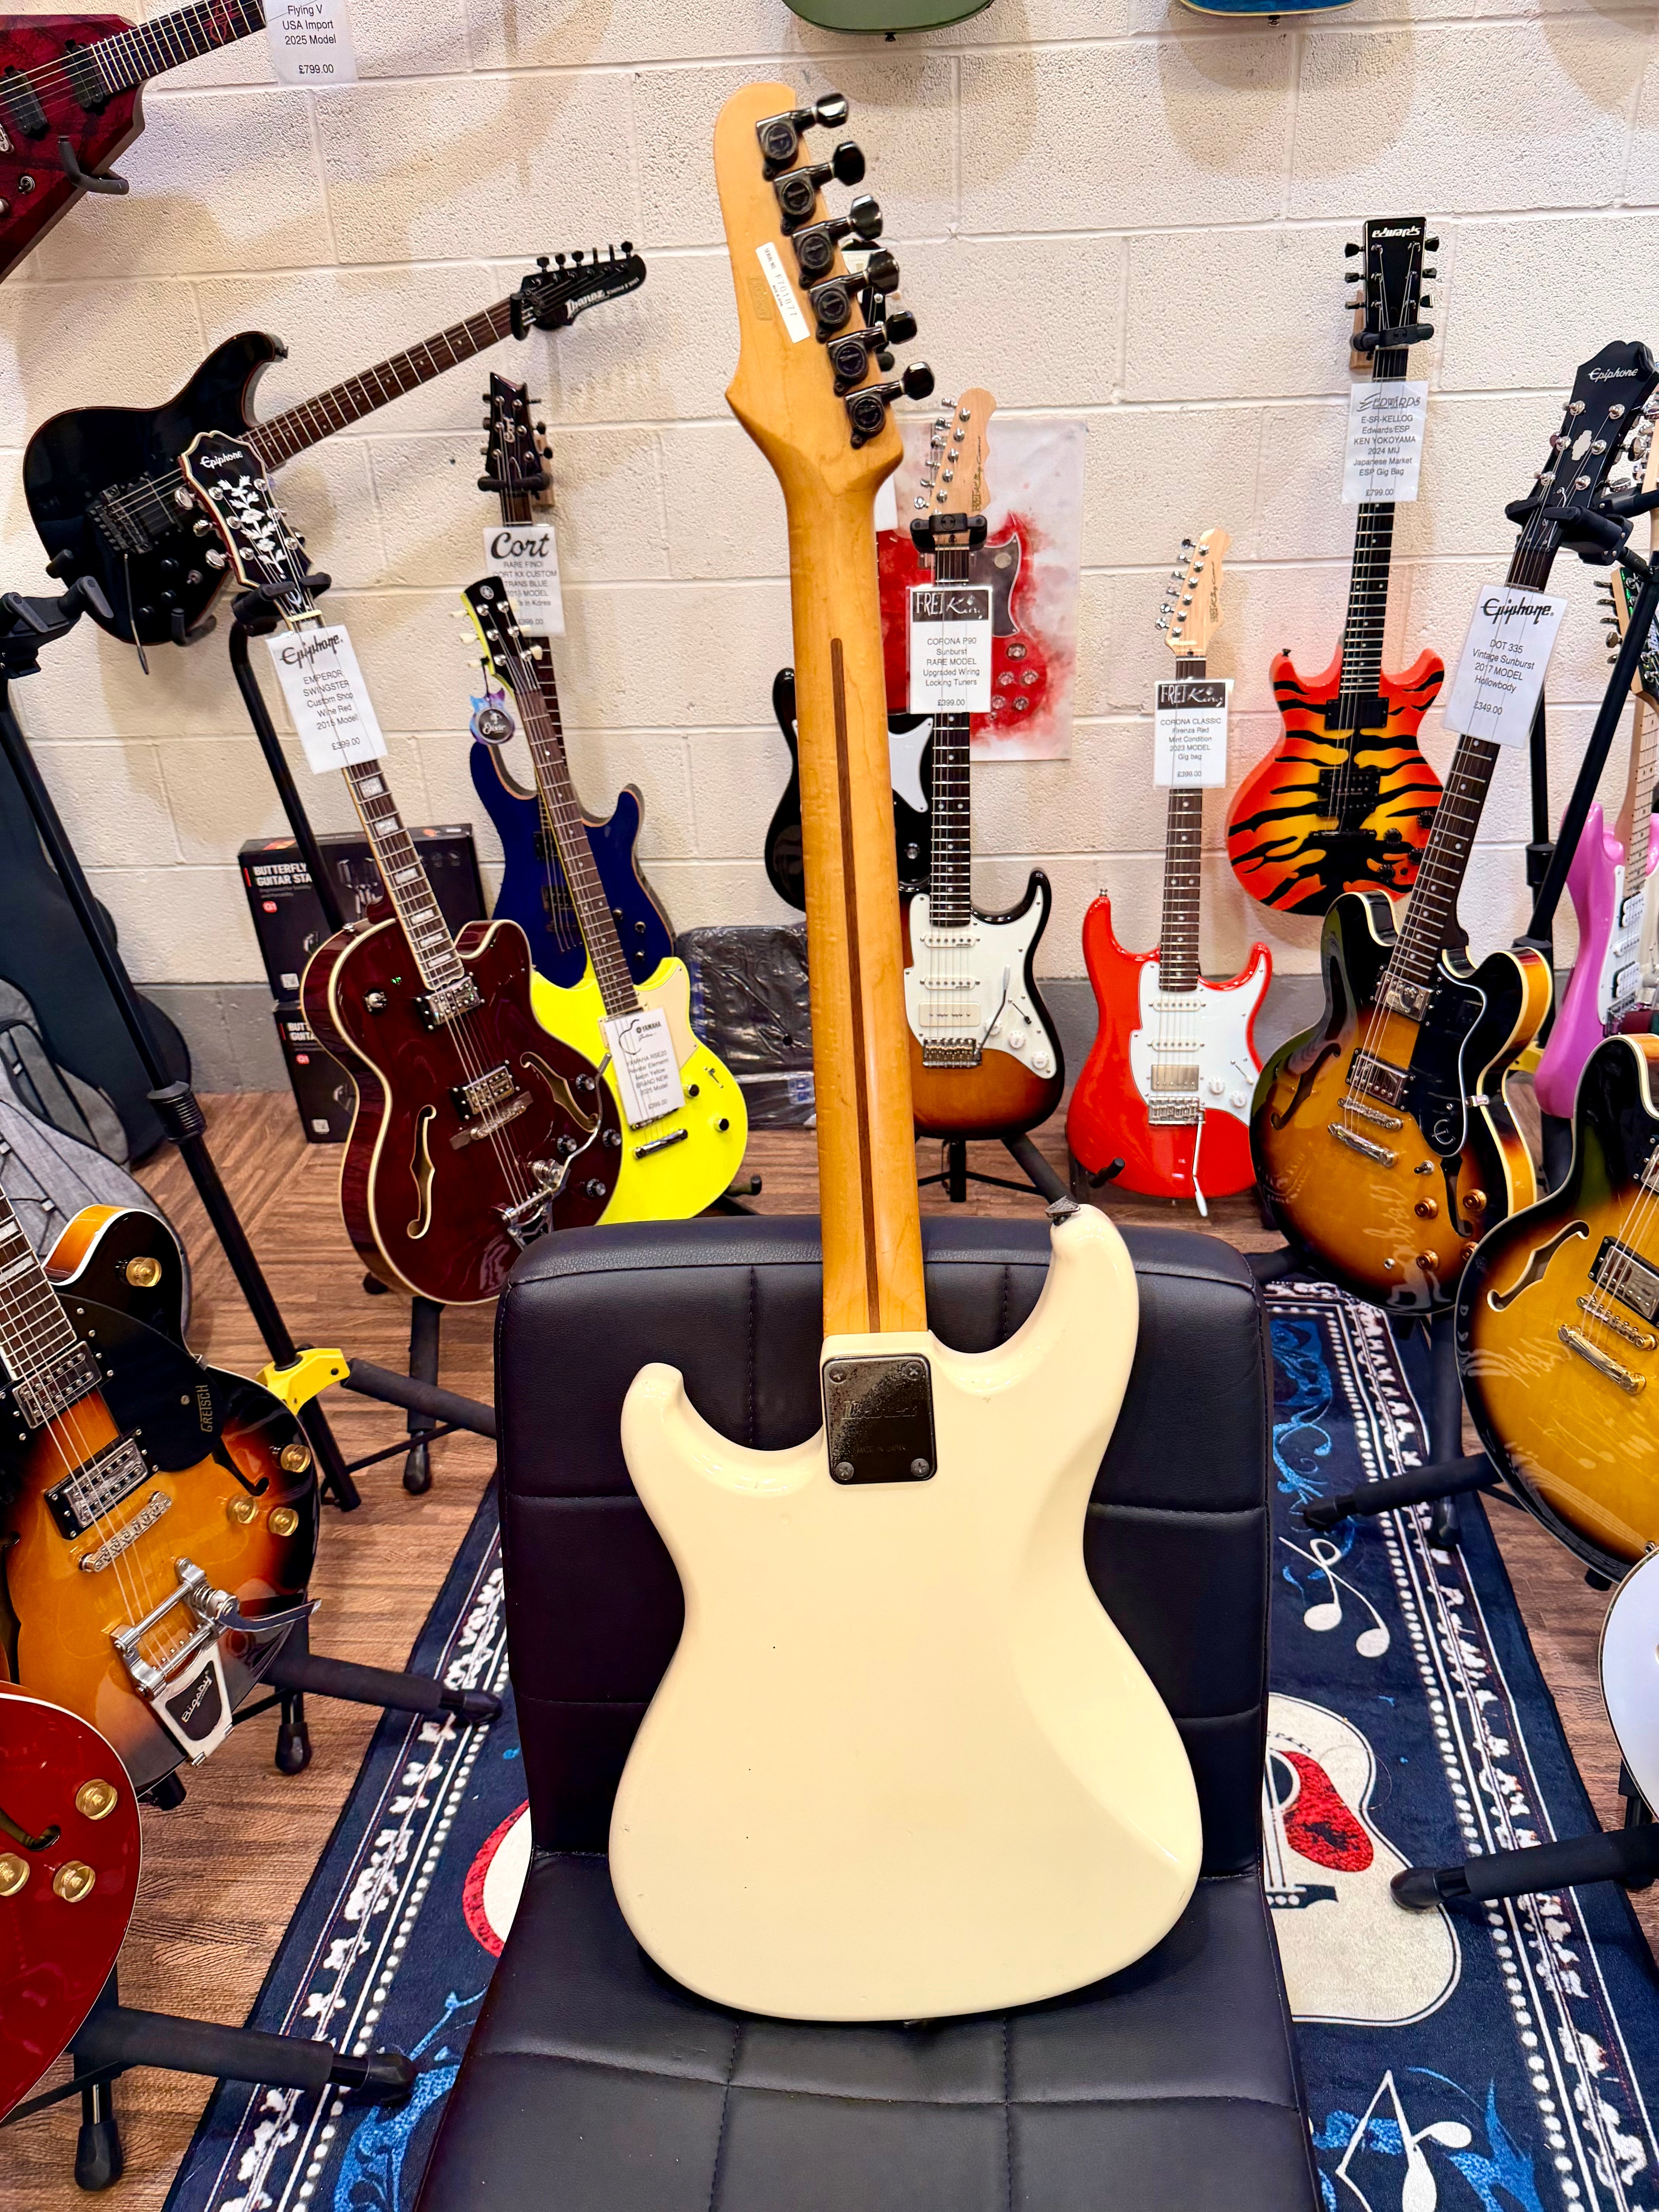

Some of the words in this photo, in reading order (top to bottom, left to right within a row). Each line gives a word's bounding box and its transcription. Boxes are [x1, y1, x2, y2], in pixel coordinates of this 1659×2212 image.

[288, 5, 313, 16] Flying
[316, 5, 322, 14] V
[283, 21, 303, 30] USA
[306, 20, 333, 31] Import
[285, 36, 307, 45] 2025
[310, 34, 336, 44] Model
[299, 64, 333, 74] £799.00
[1588, 368, 1638, 383] Epiphone
[1361, 415, 1413, 423] E-SR-KELLOG
[1362, 426, 1410, 434] Edwards/ESP
[1372, 436, 1416, 444] YOKOYAMA
[200, 451, 243, 469] Epiphone
[491, 532, 550, 559] Cort
[1490, 639, 1507, 650] DOT
[1508, 644, 1523, 654] 335
[1473, 648, 1499, 663] Vintage
[1500, 655, 1535, 670] Sunburst
[303, 670, 343, 684] EMPEROR
[1475, 663, 1492, 673] 2017
[1494, 666, 1523, 680] MODEL
[303, 680, 350, 696] SWINGSTER
[1475, 675, 1516, 693] Hollowbody
[307, 697, 336, 708] Custom
[337, 692, 353, 702] Shop
[1161, 685, 1188, 704] FRET
[317, 708, 337, 718] Wine
[338, 705, 352, 713] Red
[1474, 701, 1503, 715] £349.00
[331, 737, 360, 750] £399.00
[253, 862, 307, 876] BUTTERFLY
[256, 874, 292, 886] GUITAR
[292, 873, 313, 883] STA
[642, 1021, 661, 1032] YAMAHA
[627, 1056, 649, 1065] YAMAHA
[636, 1079, 655, 1089] BRAND
[195, 1384, 213, 1432] GRETSCH
[181, 1675, 212, 1723] Bigsby
